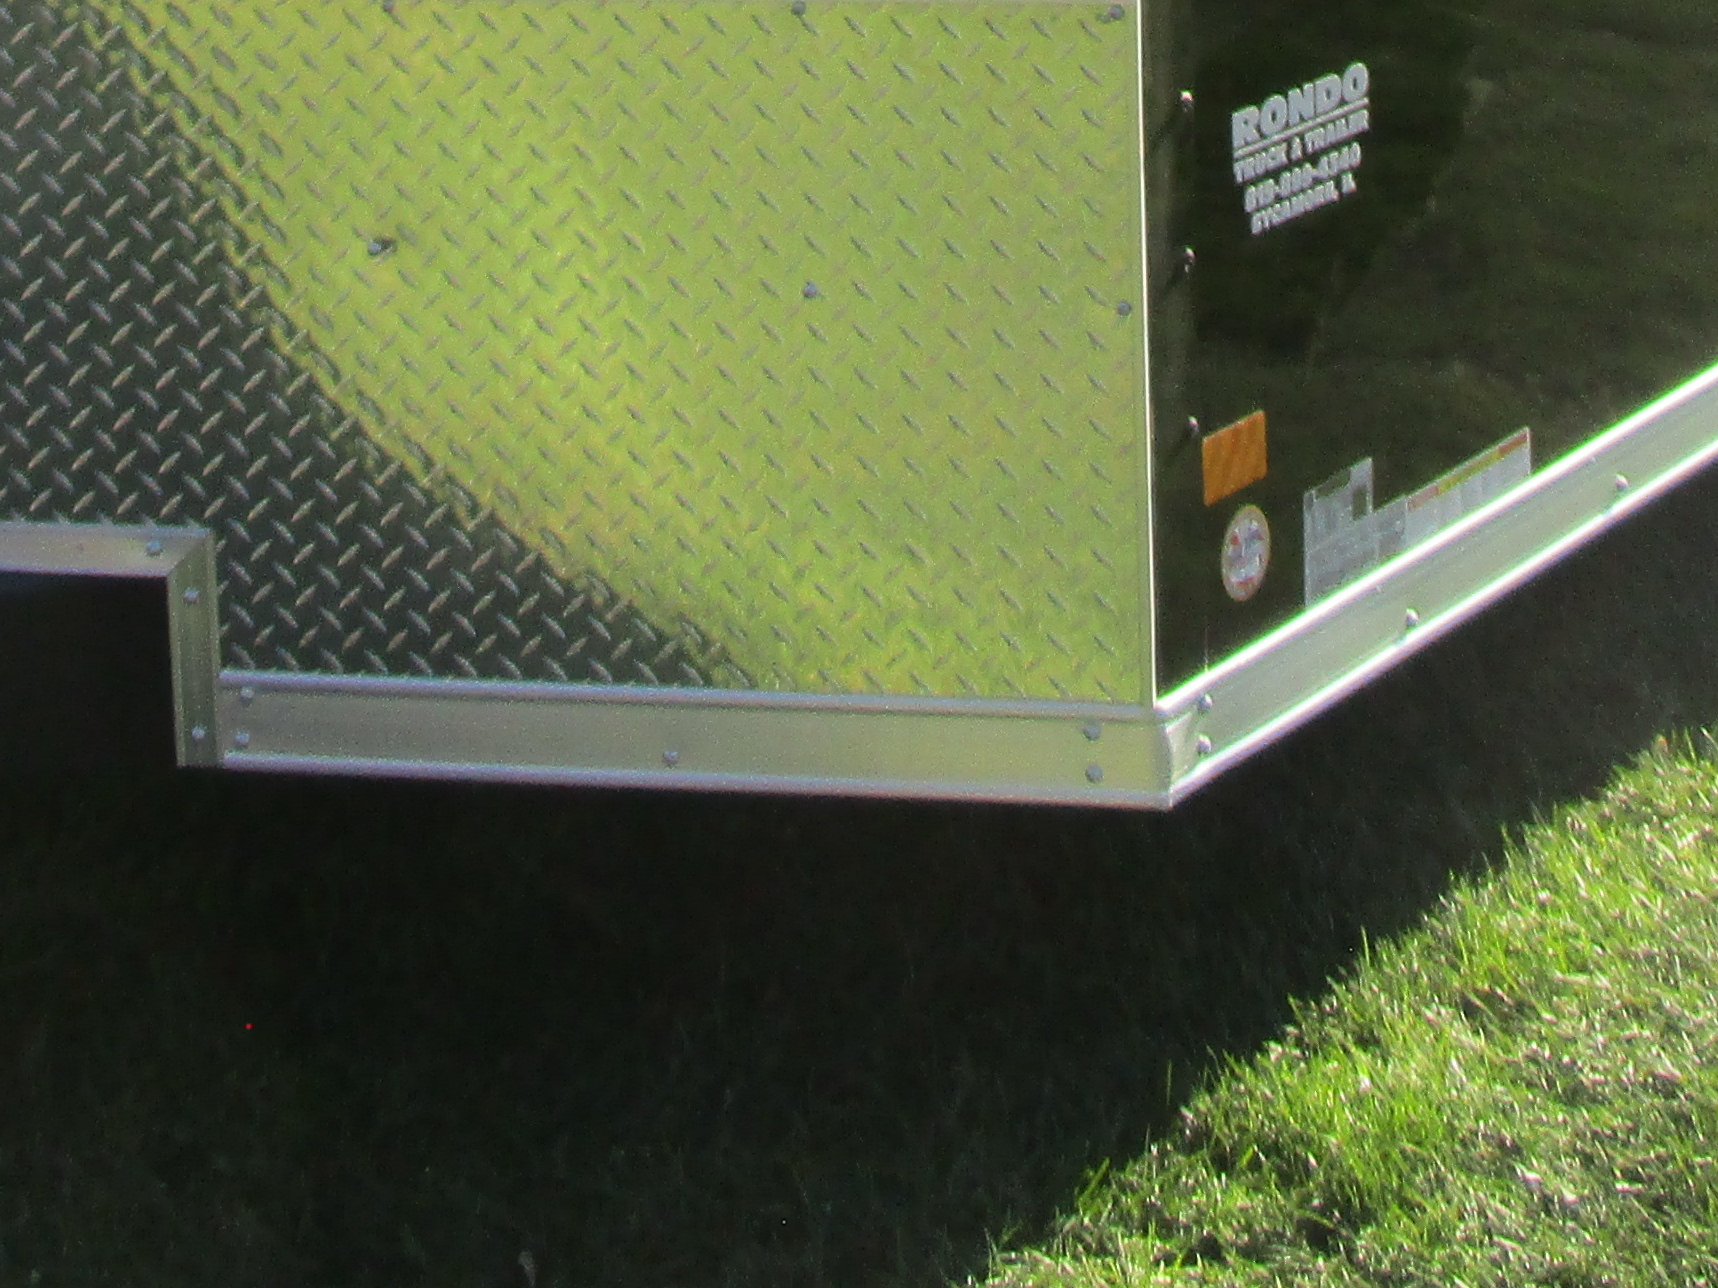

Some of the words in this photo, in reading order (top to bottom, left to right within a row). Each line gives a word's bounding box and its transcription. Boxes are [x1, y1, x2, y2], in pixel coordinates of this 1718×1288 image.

[1231, 61, 1370, 152] RONDO
[1233, 142, 1289, 184] TRUCK
[1304, 108, 1370, 155] TRAILER
